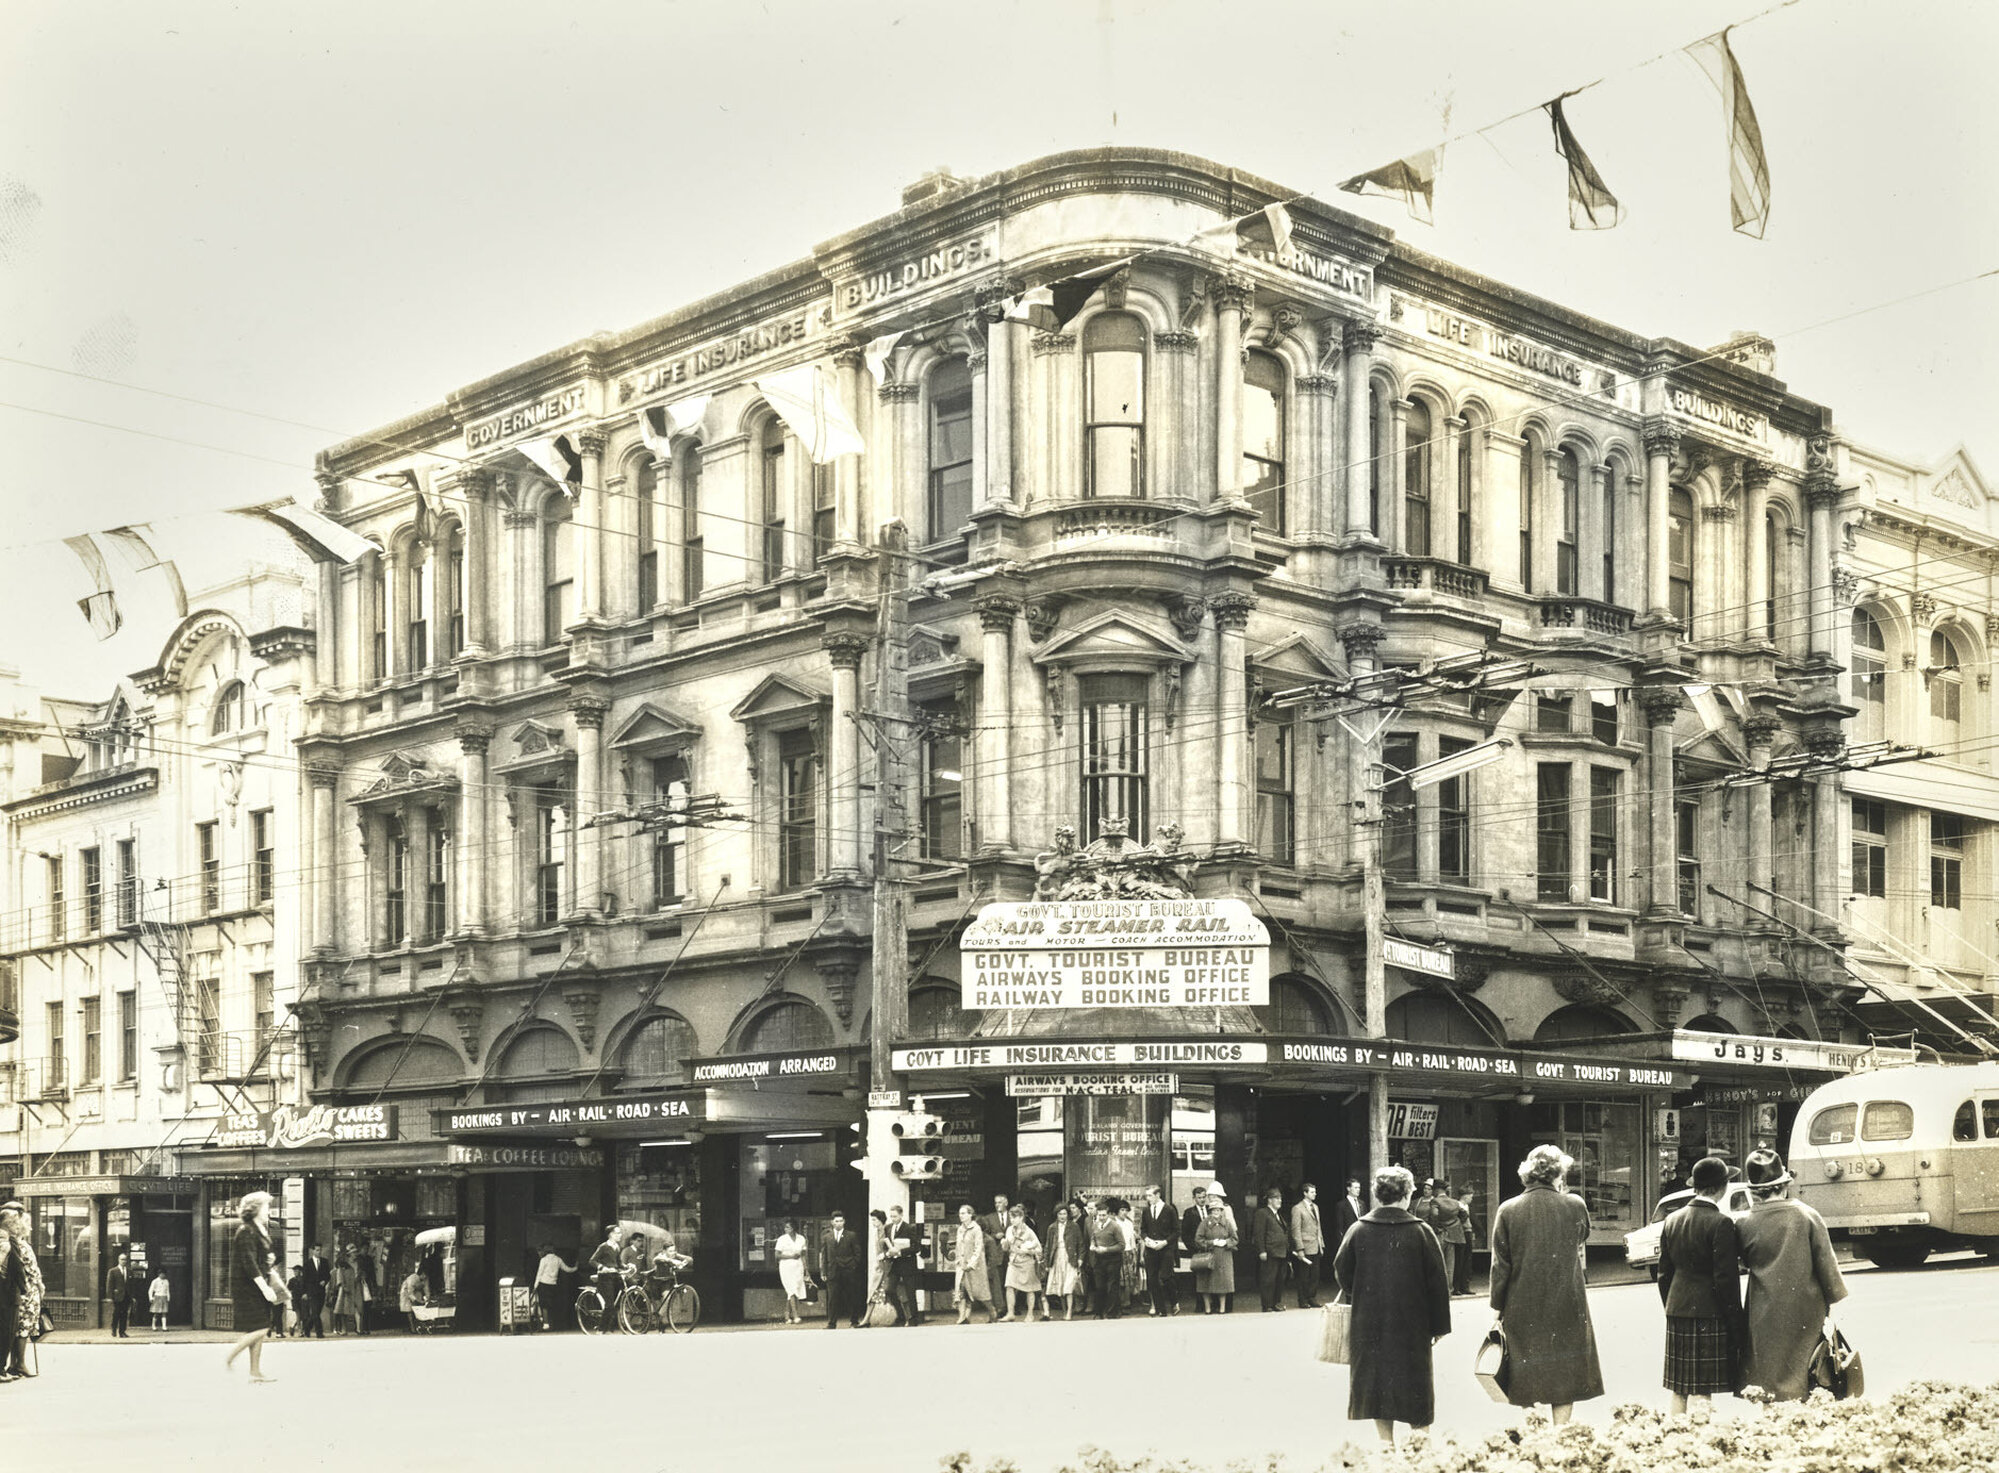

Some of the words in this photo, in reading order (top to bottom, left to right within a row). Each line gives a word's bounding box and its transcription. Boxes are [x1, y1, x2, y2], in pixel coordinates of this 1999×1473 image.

[643, 362, 685, 394] LIFE
[693, 317, 807, 376] INSURANCE
[1427, 309, 1471, 346] LIFE
[1489, 333, 1582, 386] INSURANCE
[467, 388, 586, 450] GOVERNMENT
[1070, 903, 1143, 919] TOURIST
[1150, 902, 1215, 917] BUREAU
[1176, 918, 1230, 933] RAIL
[965, 939, 1000, 947] TOURS
[1008, 938, 1027, 946] and
[1046, 937, 1086, 945] MOTOR
[1111, 936, 1147, 944] COACH
[1154, 934, 1256, 944] ACCOMMODATION
[975, 953, 1033, 969] GOVT.
[1048, 951, 1145, 968] TOURIST
[1164, 950, 1255, 966] BUREAU
[976, 970, 1063, 987] AIRWAYS
[1081, 969, 1170, 985] BOOKING
[1184, 968, 1251, 983] OFFICE
[976, 989, 1063, 1005] RAILWAY
[1081, 988, 1170, 1004] BOOKING
[1184, 987, 1251, 1003] OFFICE
[906, 1050, 944, 1067] GOVT
[954, 1049, 991, 1065] LIFE
[1006, 1045, 1116, 1063] INSURANCE
[1134, 1044, 1243, 1061] BUILDINGS
[1284, 1044, 1347, 1063] BOOKINGS
[1355, 1048, 1371, 1064] BY
[694, 1061, 769, 1080] ACCOMMODATION
[779, 1056, 837, 1075] ARRANGED
[1573, 1065, 1621, 1081] TOURIST
[1629, 1068, 1673, 1085] BUREAU
[1015, 1076, 1066, 1086] AIRWAYS
[1072, 1075, 1126, 1085] BOOKING
[1130, 1075, 1170, 1084] OFFICE
[337, 1106, 384, 1123] CAKES
[451, 1112, 502, 1129] BOOKINGS
[511, 1110, 527, 1125] BY
[1409, 1105, 1437, 1120] filters
[227, 1114, 259, 1130] TEAS
[334, 1122, 388, 1140] SWEETS
[1408, 1121, 1433, 1138] BEST
[217, 1130, 267, 1147] COFFEES
[456, 1147, 483, 1164] TEA
[492, 1148, 546, 1165] COFFEE
[552, 1150, 605, 1166] LOUNGE
[1848, 1162, 1863, 1175] 18
[128, 1181, 161, 1193] GOVT
[166, 1181, 191, 1192] LIFE
